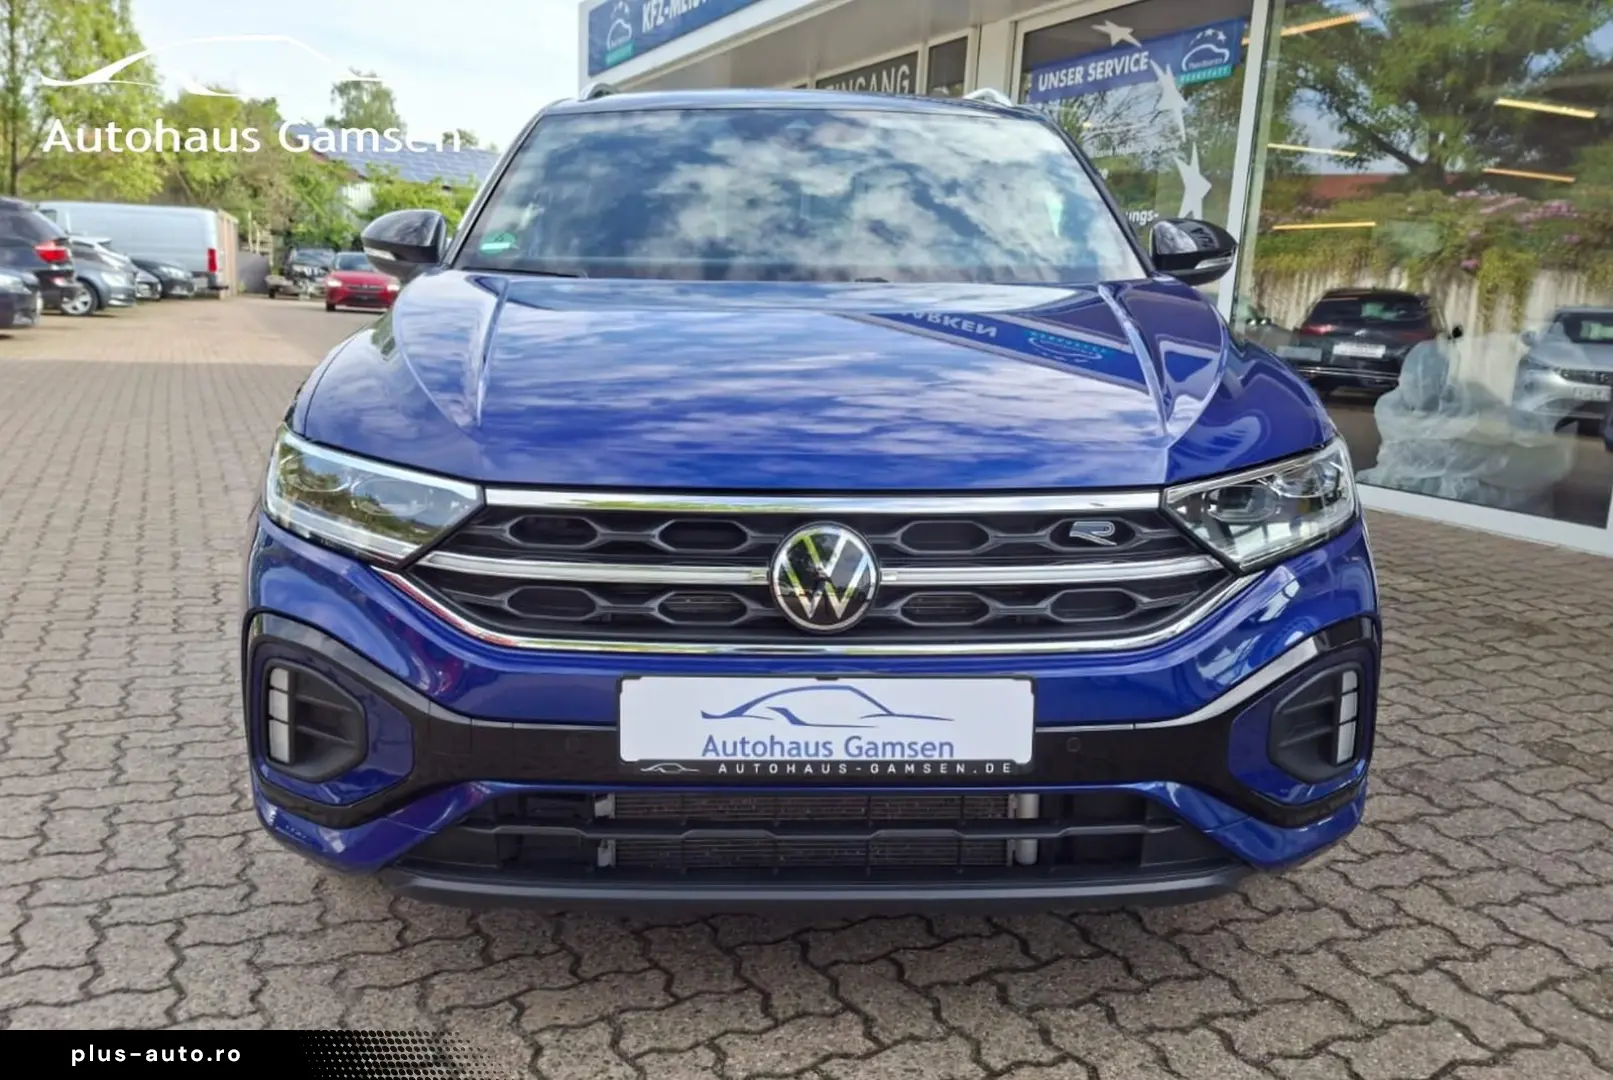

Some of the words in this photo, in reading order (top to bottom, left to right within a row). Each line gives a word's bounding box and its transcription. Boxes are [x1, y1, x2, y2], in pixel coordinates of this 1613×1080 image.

[825, 64, 910, 95] GANG
[1038, 66, 1084, 92] UNSER
[1087, 51, 1149, 82] SERVICE
[701, 734, 834, 759] Autohaus
[843, 735, 955, 759] Gamsen
[717, 762, 1012, 775] AUTOHAUS-GAMSEN.DE
